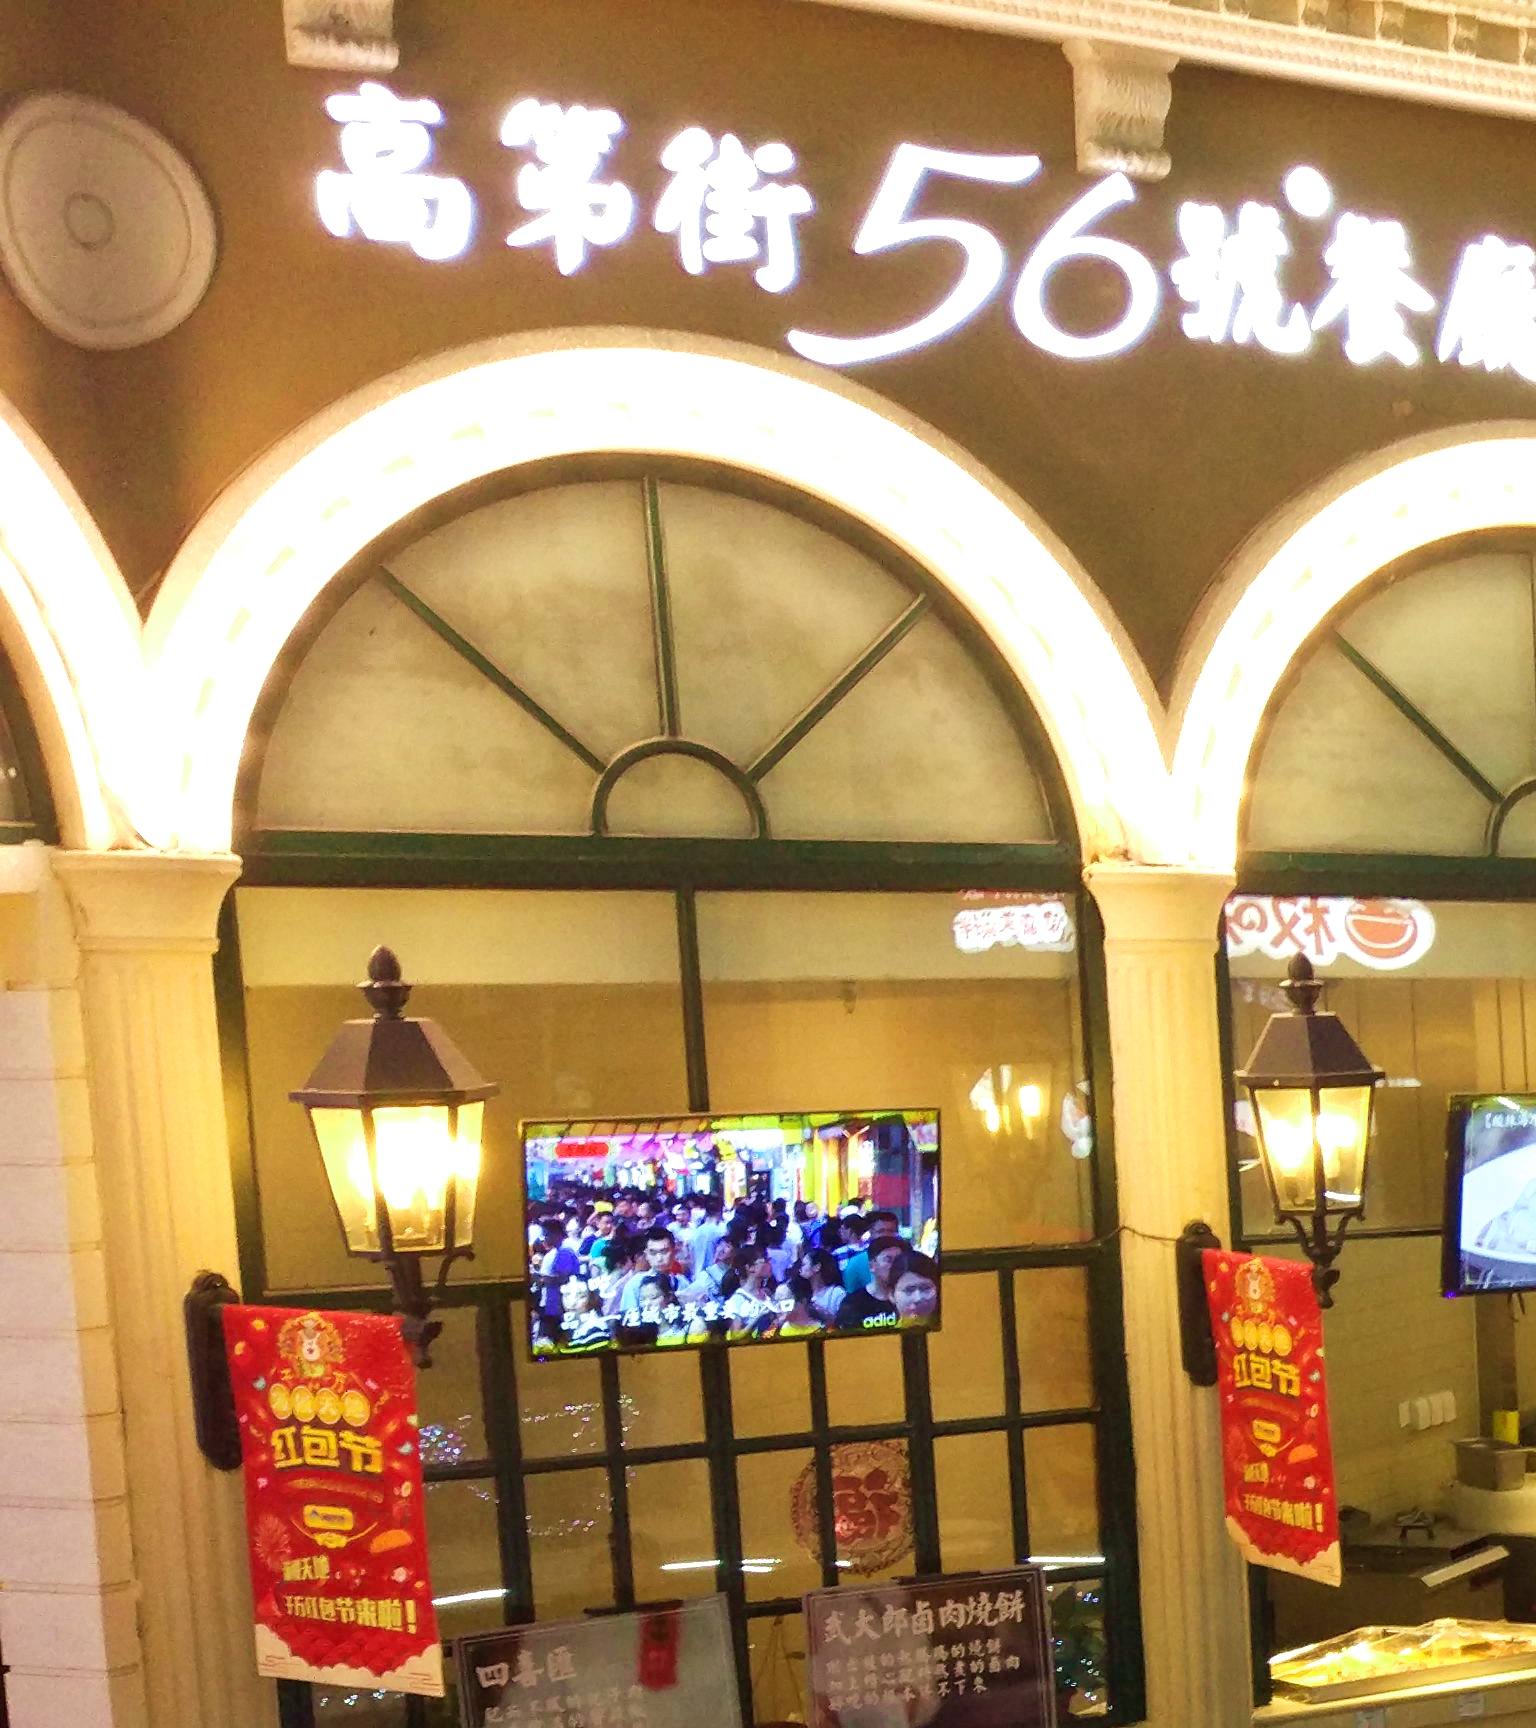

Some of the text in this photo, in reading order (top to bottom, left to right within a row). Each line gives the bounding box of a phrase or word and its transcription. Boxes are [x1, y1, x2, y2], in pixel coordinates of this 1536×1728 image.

[1232, 1352, 1302, 1398] 红包节
[271, 1424, 385, 1475] 红包节
